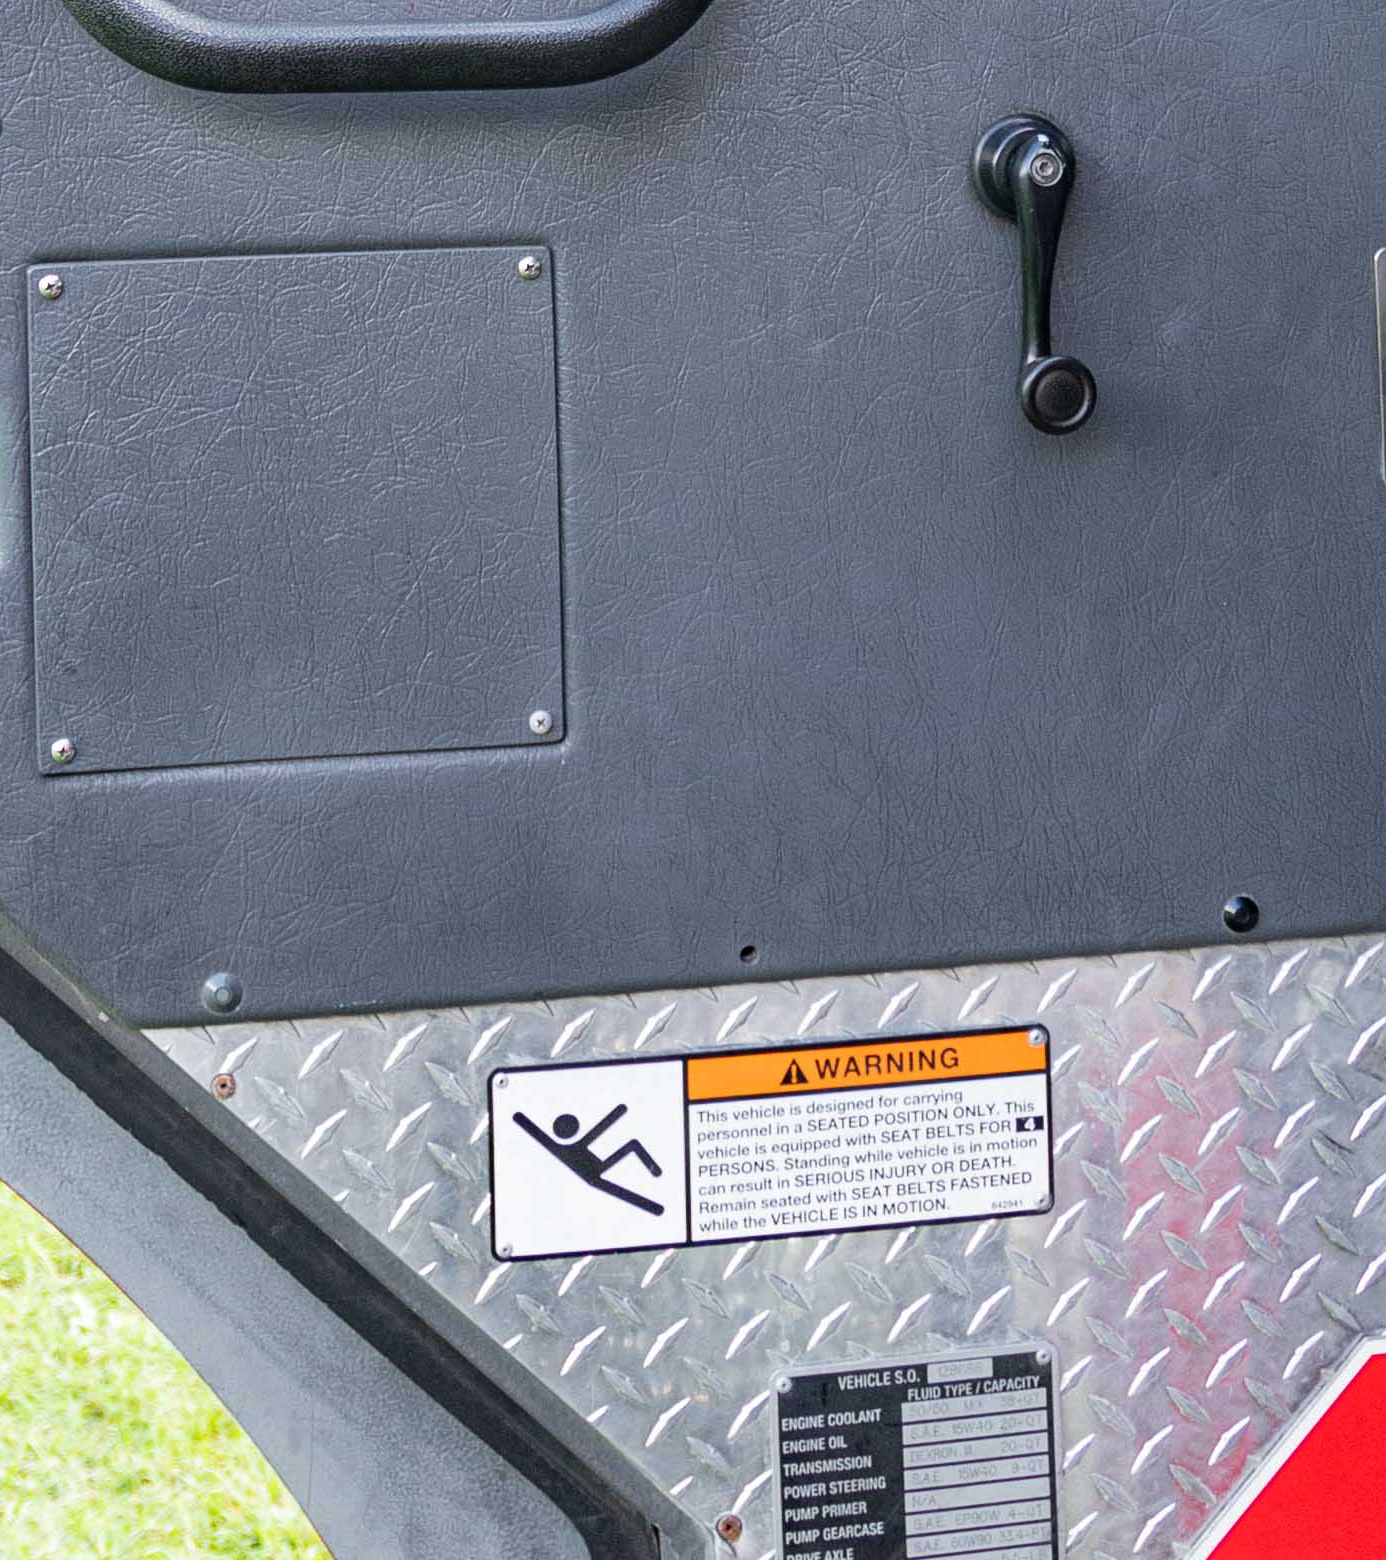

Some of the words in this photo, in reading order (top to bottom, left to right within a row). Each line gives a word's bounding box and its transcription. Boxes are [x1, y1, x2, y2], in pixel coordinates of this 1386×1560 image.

[815, 1047, 959, 1080] WARNING
[697, 1111, 728, 1124] This
[733, 1105, 785, 1120] vehicle
[790, 1105, 801, 1116] is
[806, 1096, 874, 1114] designed
[879, 1095, 898, 1108] for
[903, 1091, 963, 1106] carrying
[697, 1124, 772, 1144] personnel
[777, 1123, 789, 1135] in
[794, 1124, 802, 1134] a
[807, 1115, 869, 1132] SEATED
[875, 1108, 948, 1126] POSITION
[953, 1103, 999, 1119] ONLY.
[1005, 1101, 1035, 1113] This
[698, 1144, 750, 1160] vehicle
[756, 1143, 767, 1154] is
[772, 1137, 841, 1157] equipped
[845, 1133, 876, 1146] with
[881, 1129, 923, 1144] SEAT
[926, 1125, 975, 1140] BELTS
[980, 1120, 1011, 1134] FOR
[699, 1159, 779, 1177] PERSONS.
[784, 1155, 850, 1171] Standing
[855, 1150, 893, 1164] while
[898, 1145, 948, 1160] vehicle
[953, 1142, 965, 1154] is
[970, 1141, 982, 1152] in
[987, 1137, 1037, 1150] motion
[699, 1184, 726, 1196] can
[731, 1179, 773, 1193] result
[778, 1178, 790, 1189] in
[795, 1169, 864, 1187] SERIOUS
[870, 1163, 927, 1180] INJURY
[932, 1161, 954, 1175] OR
[960, 1156, 1015, 1172] DEATH.
[699, 1199, 756, 1214] Remain
[761, 1194, 811, 1209] seated
[816, 1188, 847, 1202] with
[852, 1184, 894, 1200] SEAT
[897, 1180, 946, 1196] BELTS
[951, 1171, 1032, 1191] FASTENED
[699, 1217, 738, 1232] while
[744, 1215, 767, 1228] the
[771, 1208, 838, 1225] VEHICLE
[843, 1206, 858, 1219] IS
[862, 1205, 877, 1217] IN
[883, 1199, 949, 1215] MOTION.
[838, 1371, 891, 1391] VEHICLE
[894, 1369, 920, 1384] S.O.
[907, 1388, 941, 1401] FLUID
[944, 1383, 973, 1397] TYPE
[984, 1376, 1040, 1393] CAPACITY
[781, 1414, 825, 1431] ENGINE
[828, 1408, 882, 1427] COOLANT
[782, 1438, 826, 1454] ENGINE
[829, 1436, 848, 1449] OIL
[783, 1456, 872, 1477] TRANSMISSION
[784, 1483, 826, 1499] POWER
[829, 1476, 886, 1495] STEERING
[785, 1506, 819, 1522] PUMP
[822, 1501, 867, 1518] PRIMER
[785, 1529, 820, 1545] PUMP
[823, 1521, 885, 1541] GEARCASE
